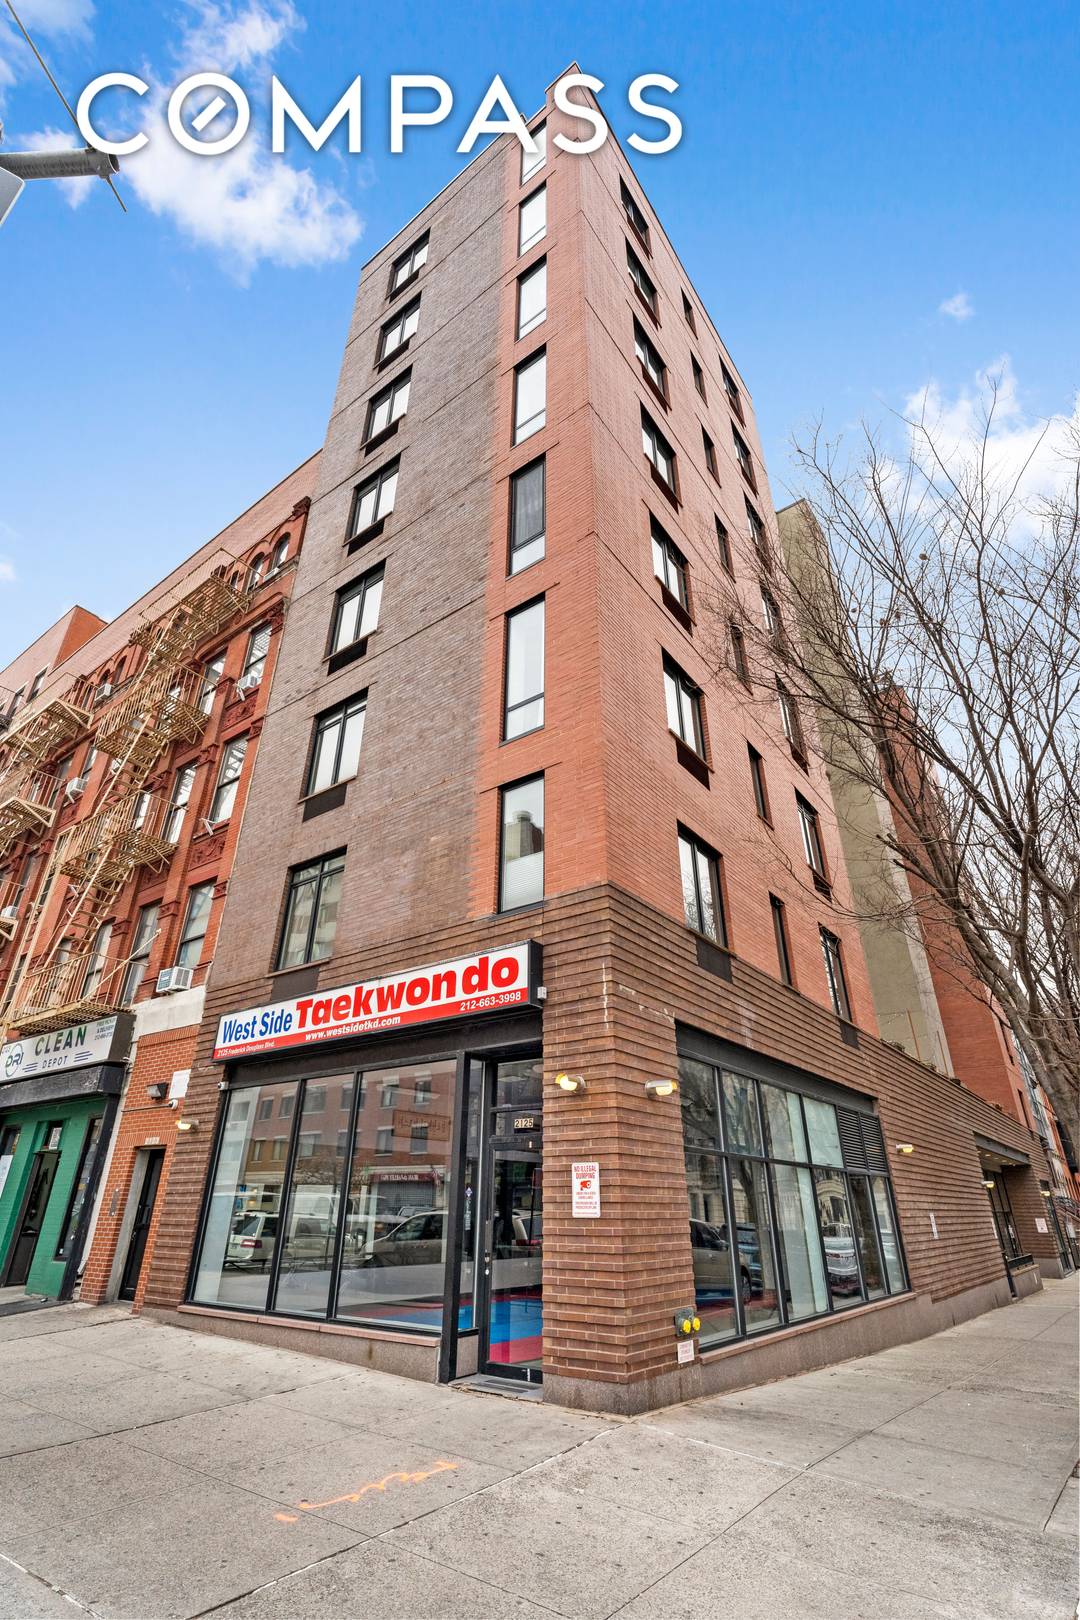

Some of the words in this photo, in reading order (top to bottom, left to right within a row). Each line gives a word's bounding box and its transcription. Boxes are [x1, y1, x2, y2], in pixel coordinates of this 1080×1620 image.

[460, 992, 522, 1012] 212-663-3998
[222, 1015, 256, 1044] West
[259, 1008, 293, 1037] Side
[305, 1016, 401, 1041] www.westsidetkd.com
[35, 1025, 88, 1057] CLEAN
[5, 1052, 25, 1068] DRI
[42, 1055, 69, 1069] DEPOT
[515, 1118, 533, 1128] 2125
[574, 1165, 580, 1173] NO
[580, 1164, 597, 1173] ILLEGAL
[575, 1172, 596, 1180] DUMPING
